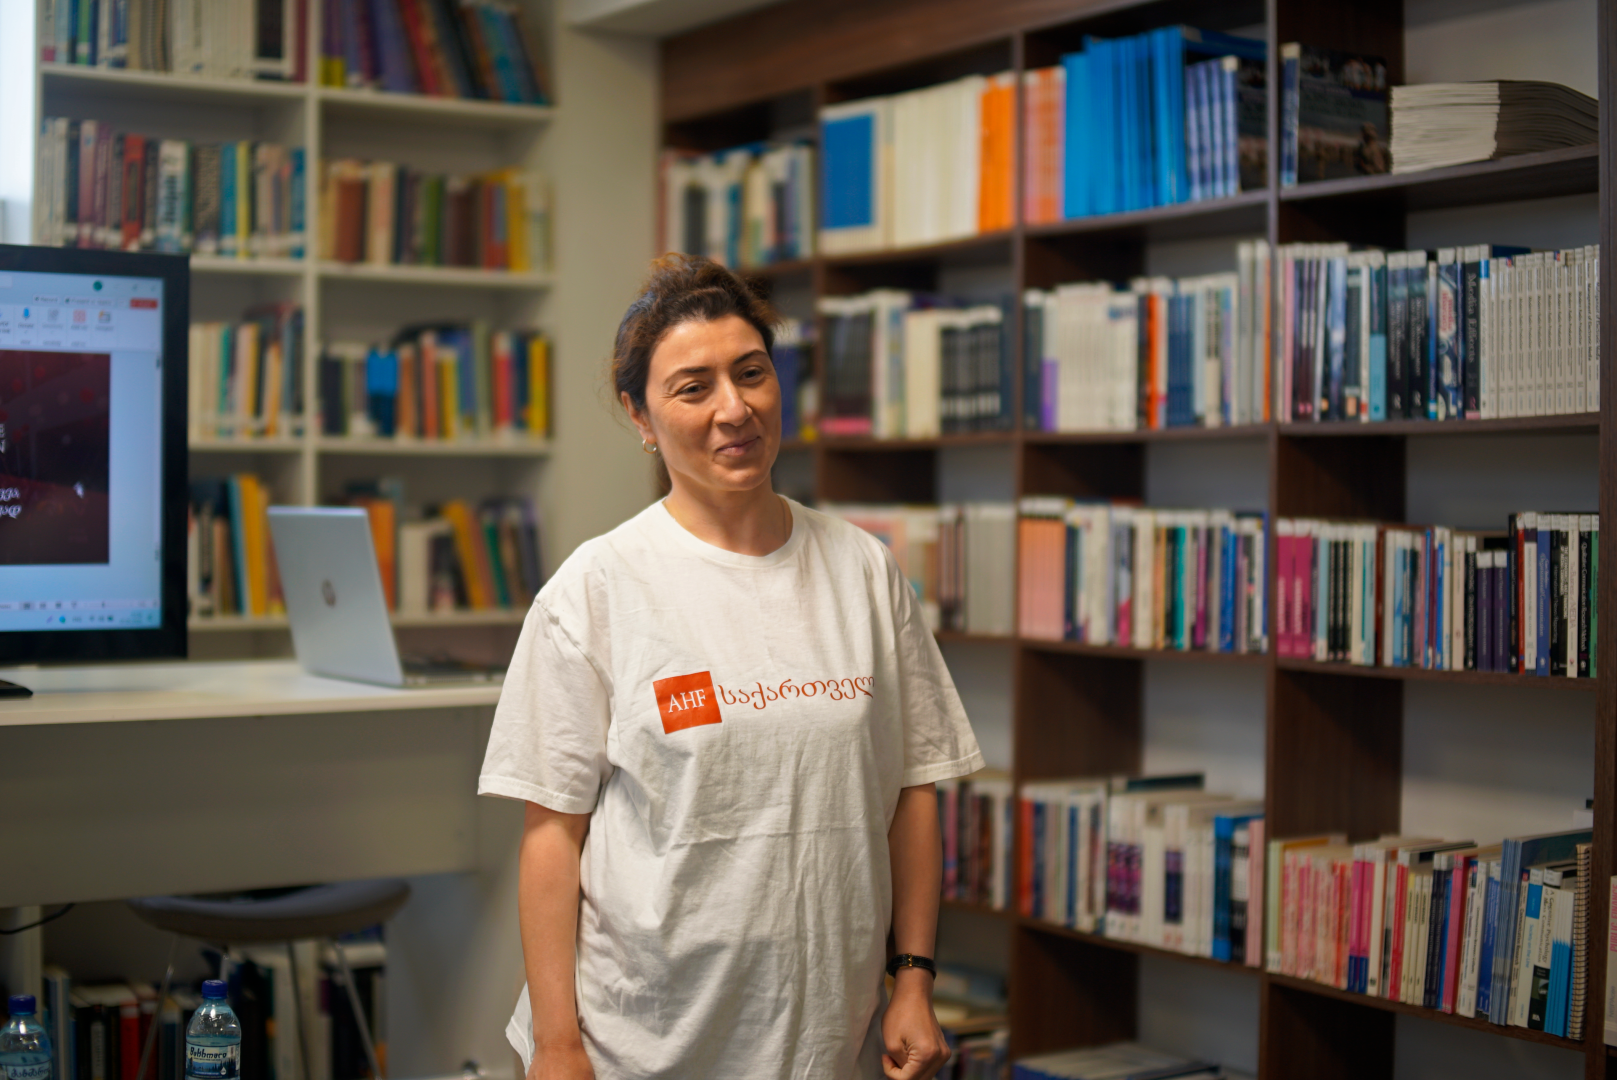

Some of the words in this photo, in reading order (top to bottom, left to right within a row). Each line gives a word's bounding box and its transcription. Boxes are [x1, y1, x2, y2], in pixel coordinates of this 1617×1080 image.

[668, 689, 706, 713] AHF
[1546, 897, 1555, 927] Cognitive
[1537, 914, 1546, 963] Communication
[1541, 929, 1552, 964] Psychology
